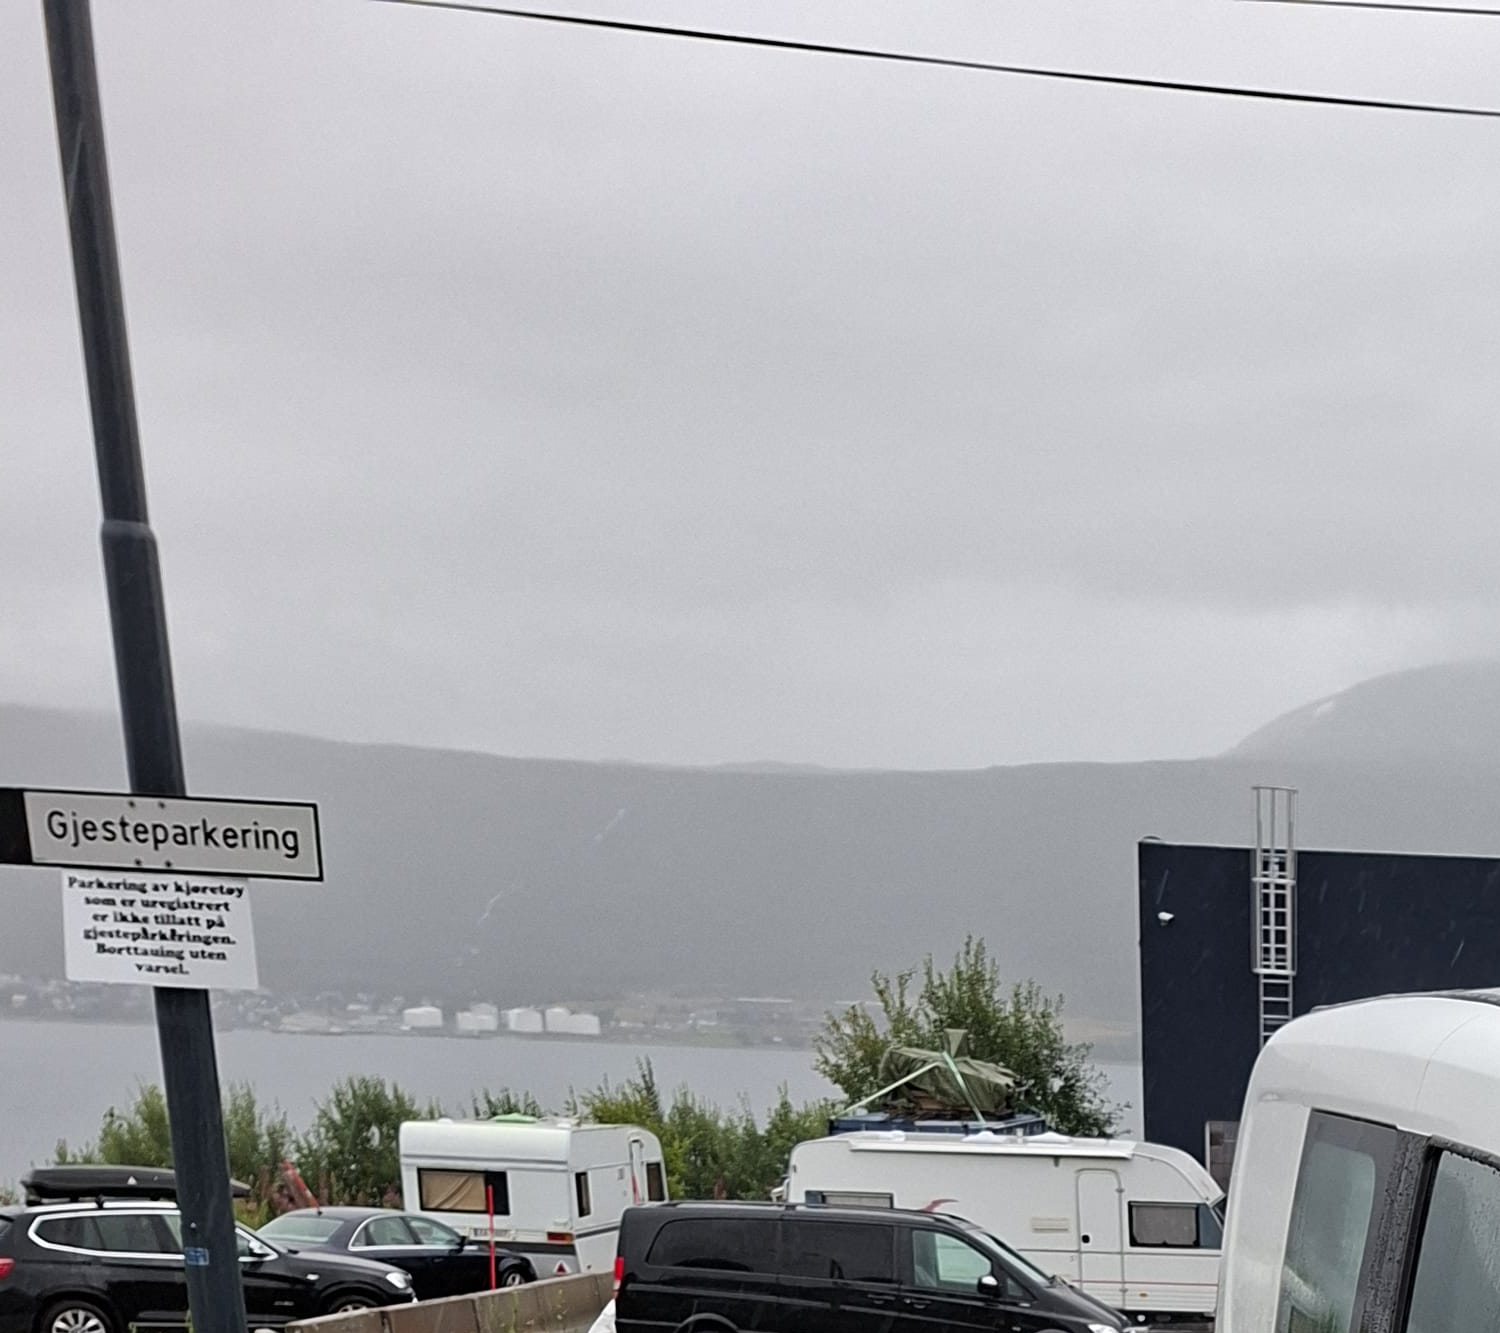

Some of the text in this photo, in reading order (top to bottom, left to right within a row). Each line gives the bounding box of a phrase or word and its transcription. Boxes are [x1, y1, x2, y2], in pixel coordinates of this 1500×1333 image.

[47, 810, 299, 859] Gjesteparkering
[68, 876, 244, 898] Parkering av kjøretøy
[84, 896, 230, 912] som er uregistrert
[92, 911, 225, 929] er ikke tillatt på
[96, 942, 227, 960] Borttauing uten
[135, 963, 190, 975] varsel.
